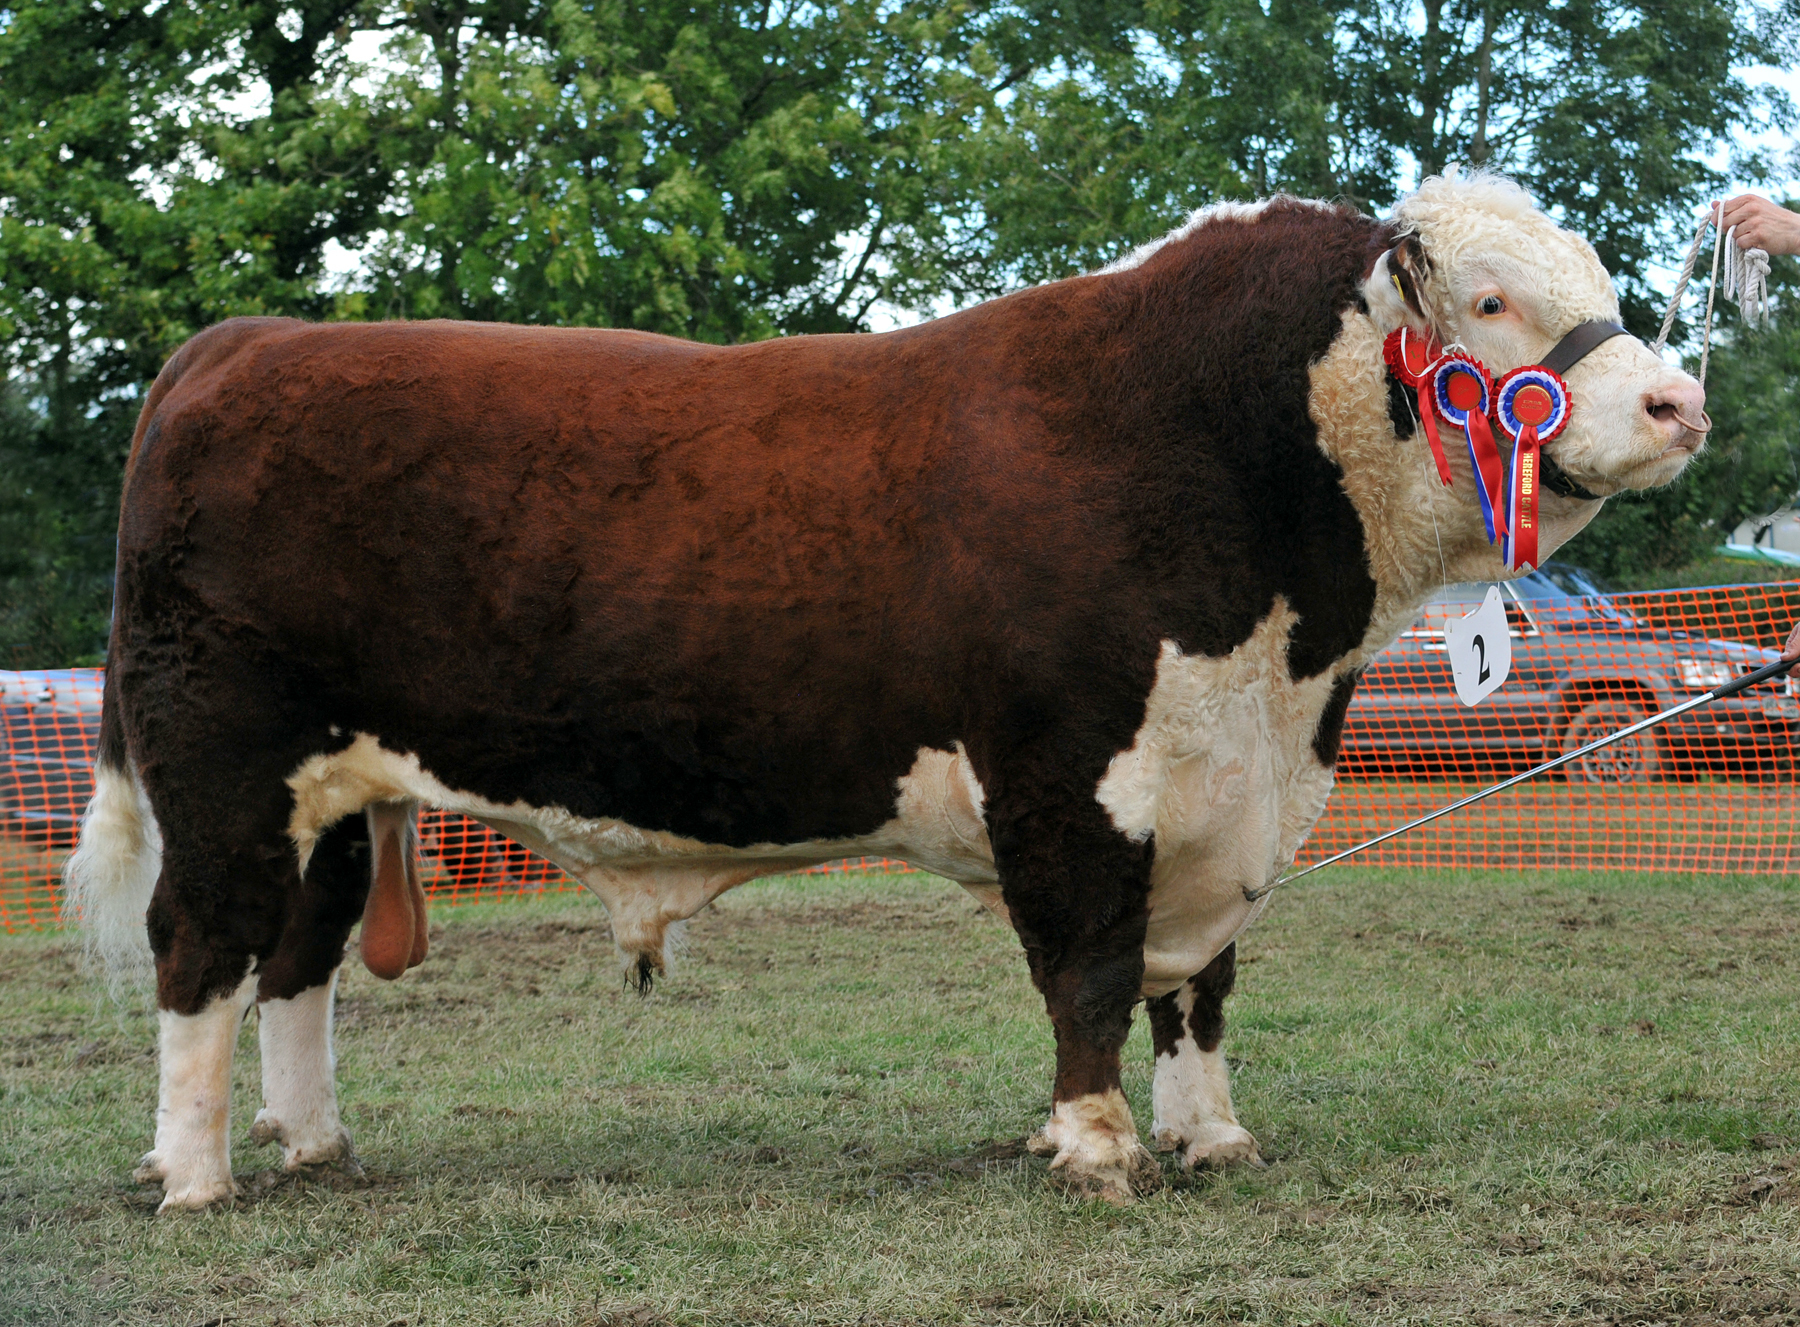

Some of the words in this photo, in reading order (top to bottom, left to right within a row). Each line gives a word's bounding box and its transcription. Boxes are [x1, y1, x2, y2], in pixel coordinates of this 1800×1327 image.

[1521, 452, 1534, 495] HEREFORD
[1521, 497, 1532, 529] CATTLE
[1472, 634, 1490, 686] 2
